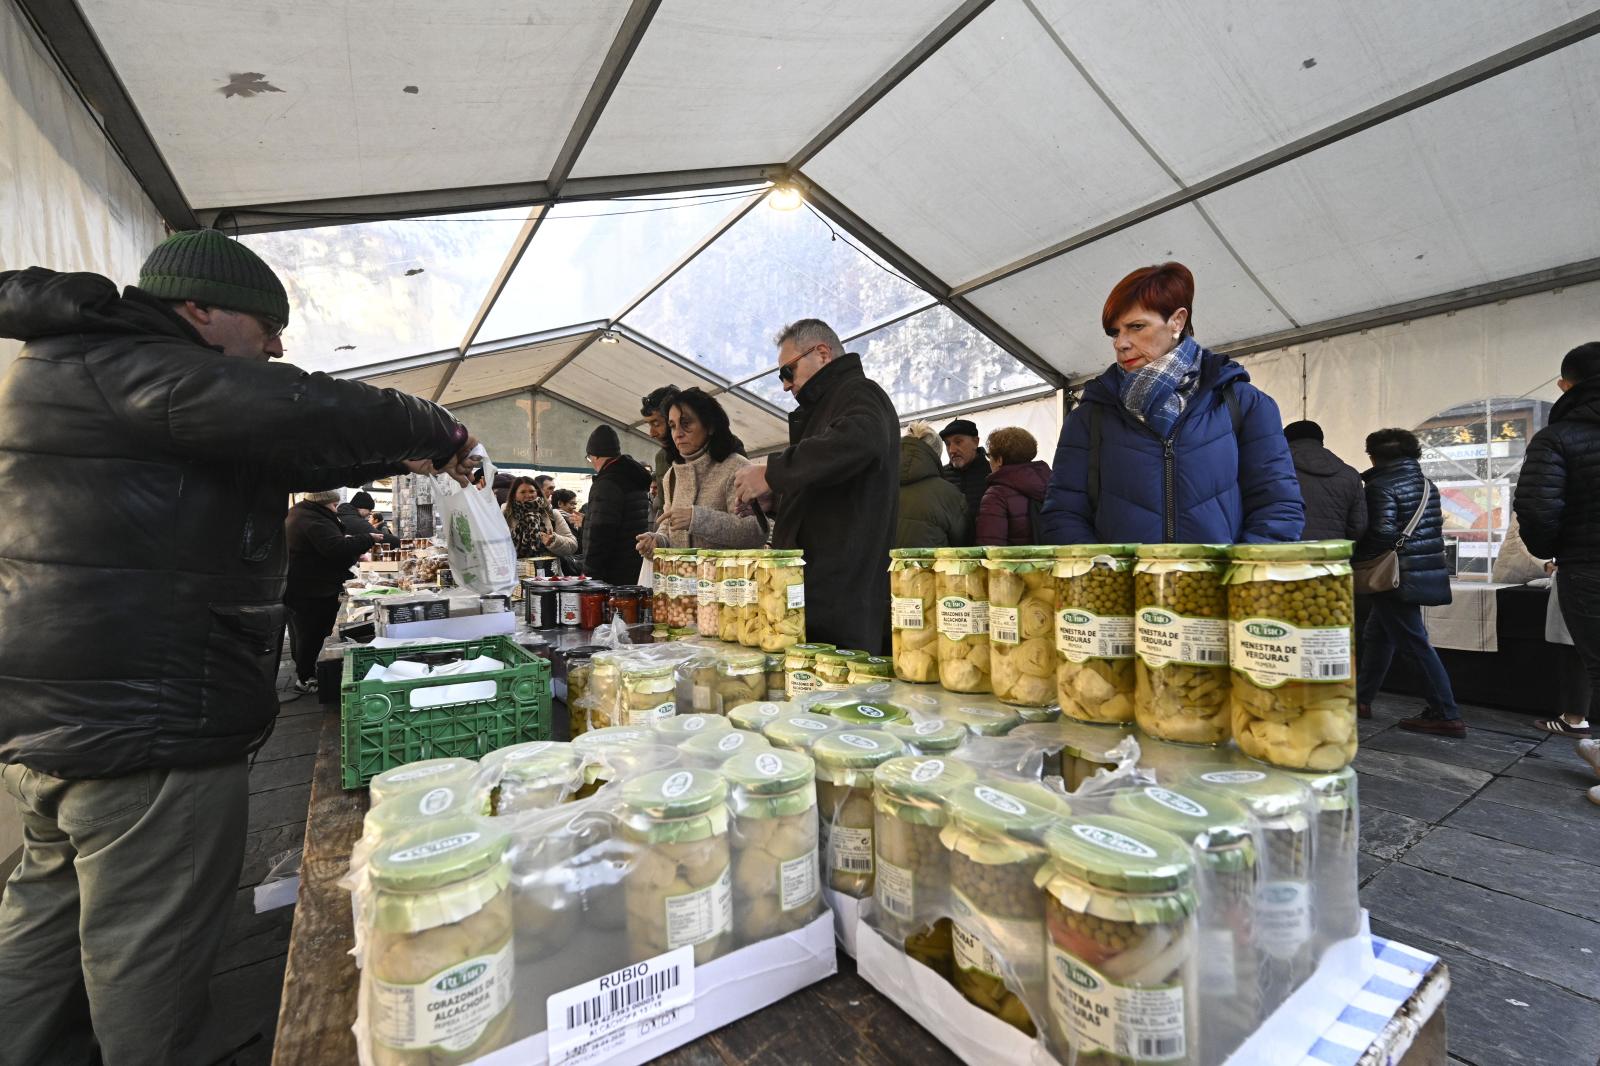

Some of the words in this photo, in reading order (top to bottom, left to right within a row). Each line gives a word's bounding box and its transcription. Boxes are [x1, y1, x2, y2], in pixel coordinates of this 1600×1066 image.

[1060, 627, 1086, 637] MENESTRA
[1138, 627, 1168, 639] MENESTRA
[1168, 632, 1180, 640] DE
[1062, 635, 1092, 644] VERDURAS
[1140, 636, 1173, 647] VERDURAS
[1240, 640, 1283, 654] MENESTRA
[1284, 645, 1298, 654] DE
[1245, 650, 1290, 663] VERDURAS
[440, 966, 486, 990] RUBIO
[599, 963, 649, 991] RUBIO
[427, 986, 484, 1013] CORAZONES
[484, 978, 495, 990] DE
[434, 991, 492, 1022] ALCACHOFA
[1095, 1003, 1110, 1017] DE
